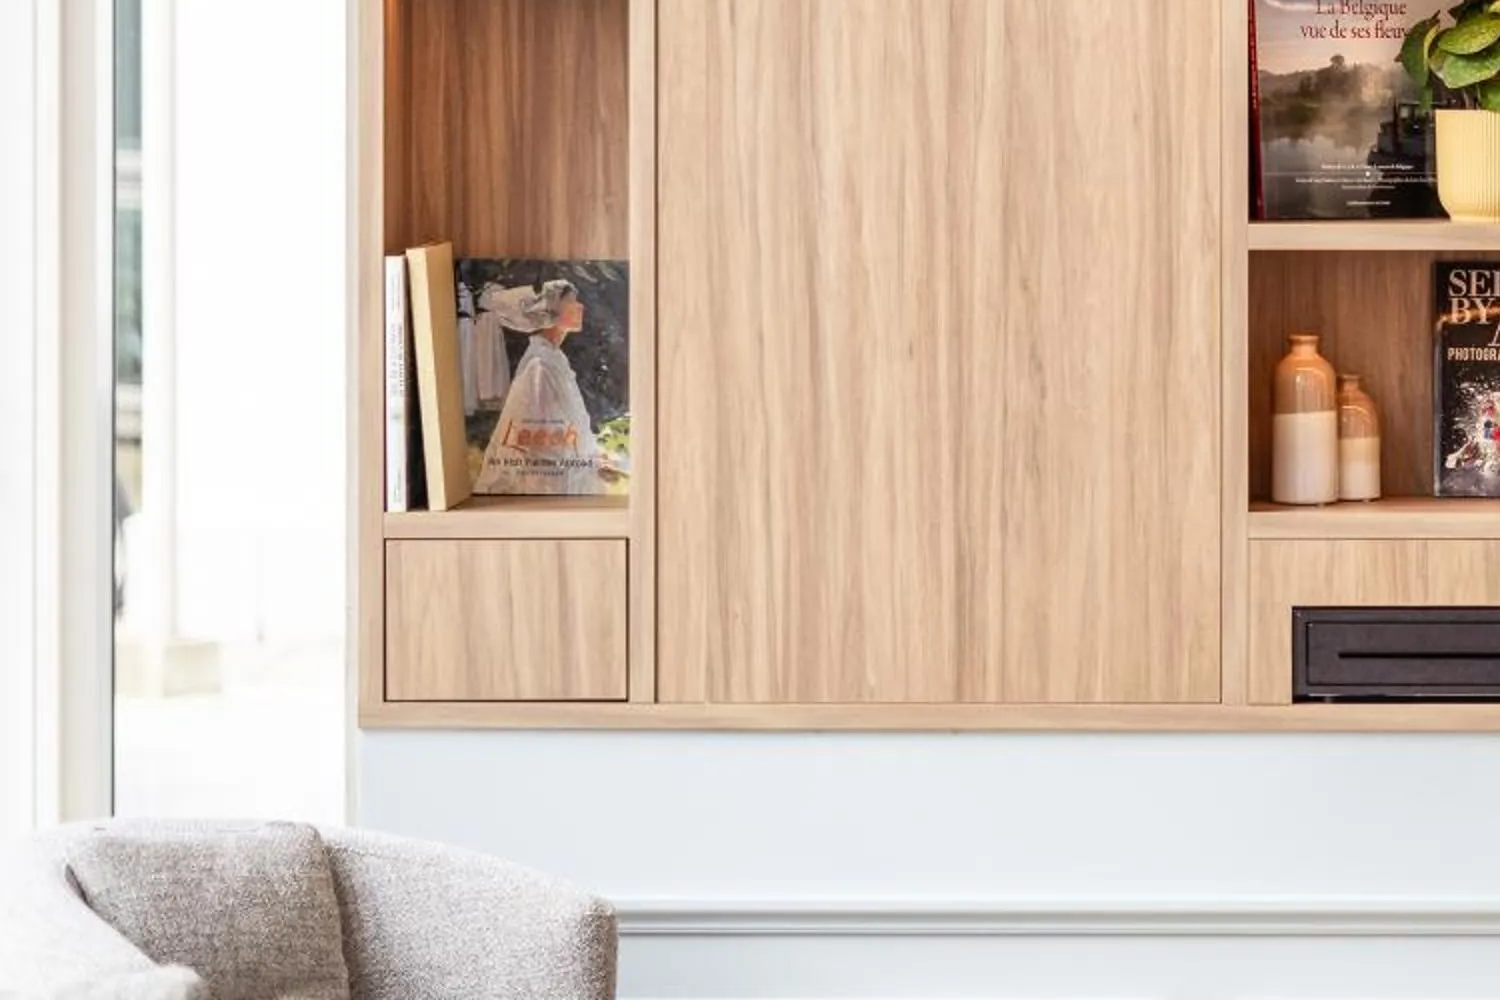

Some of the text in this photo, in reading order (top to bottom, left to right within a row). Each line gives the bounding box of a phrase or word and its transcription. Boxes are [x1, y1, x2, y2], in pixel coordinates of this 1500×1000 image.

[1300, 24, 1327, 39] vue
[1330, 19, 1345, 39] de
[1351, 25, 1371, 39] ses
[1450, 298, 1496, 325] BY
